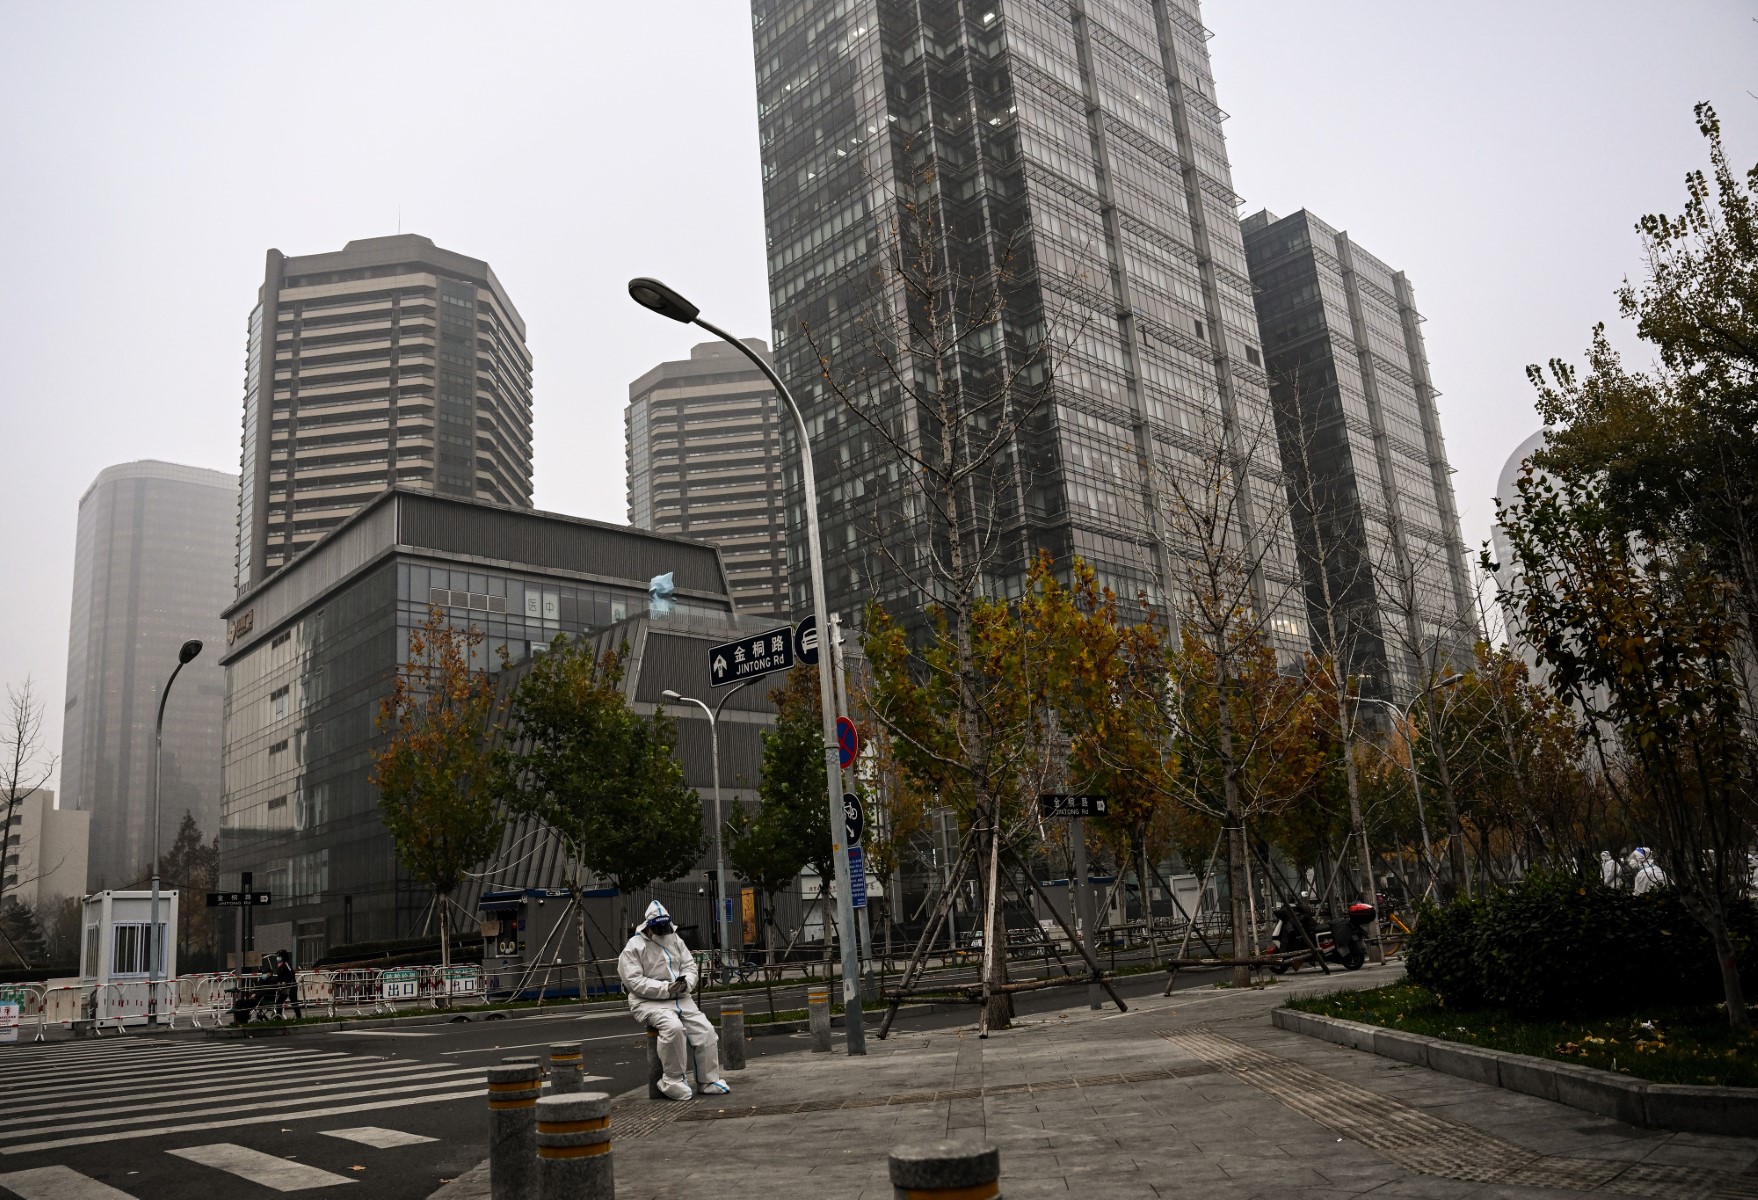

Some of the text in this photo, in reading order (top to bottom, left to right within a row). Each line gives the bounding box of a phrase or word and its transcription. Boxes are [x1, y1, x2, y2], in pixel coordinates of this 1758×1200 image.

[733, 635, 784, 663] 金桐路
[736, 654, 785, 675] JINTONG Rd
[388, 983, 414, 997] 出口
